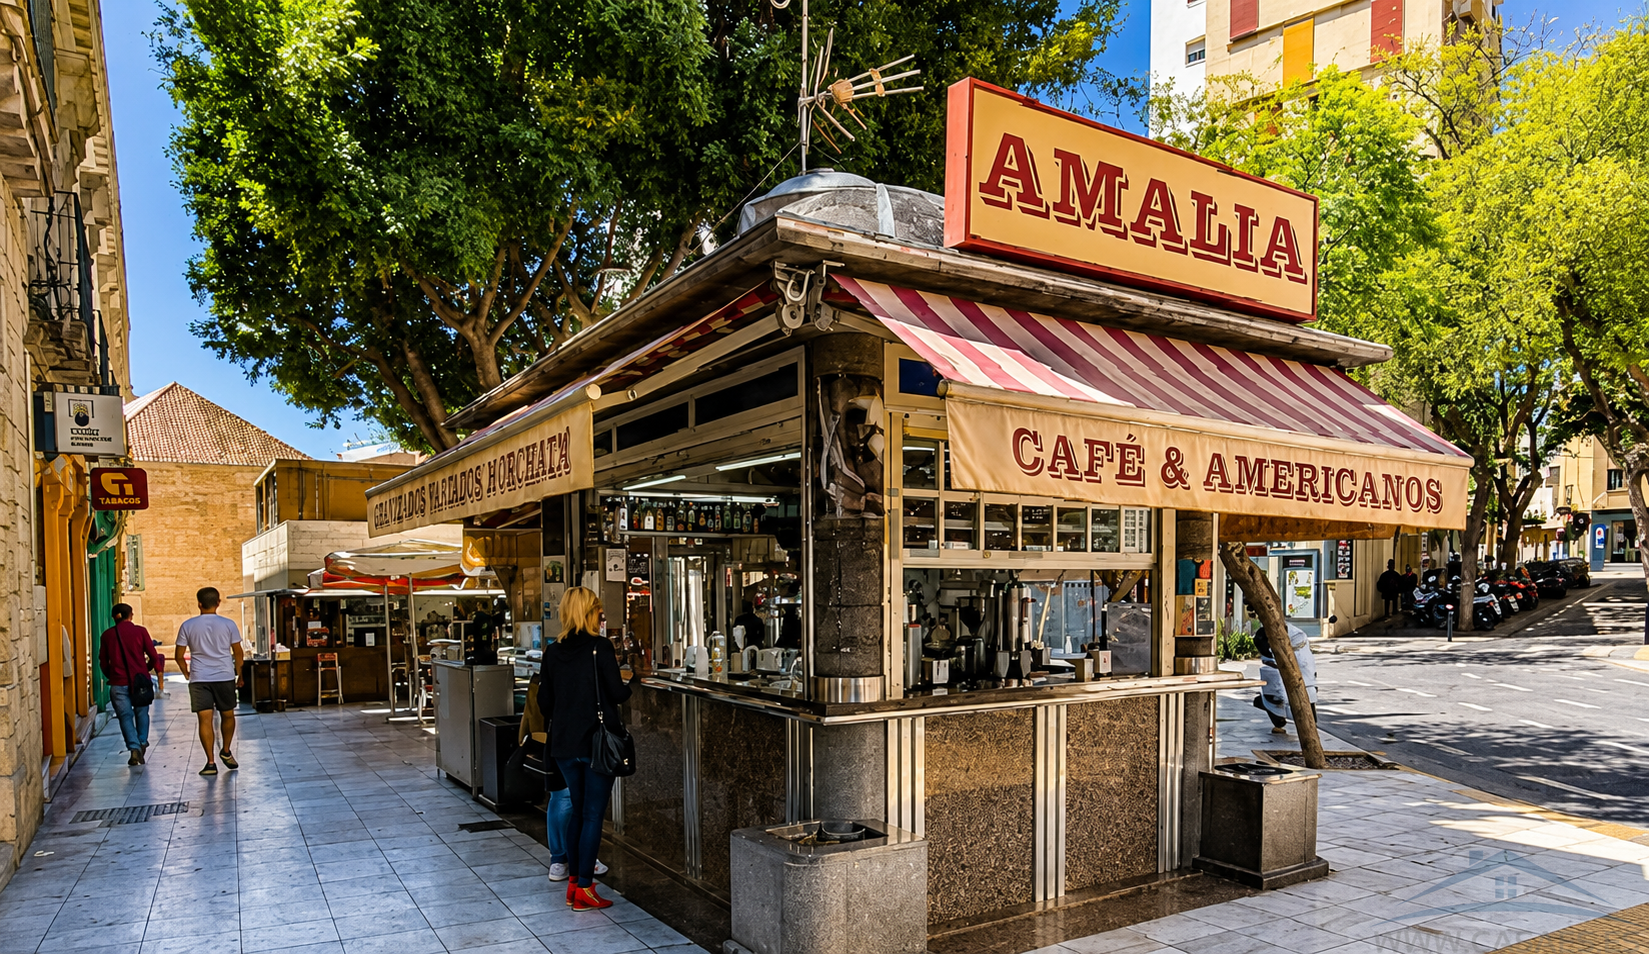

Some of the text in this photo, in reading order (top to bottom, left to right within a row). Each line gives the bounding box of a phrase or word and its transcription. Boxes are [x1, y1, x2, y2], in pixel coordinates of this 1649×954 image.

[979, 132, 1308, 285] AMALIA
[98, 497, 141, 505] TABACOS
[1012, 427, 1444, 514] CAFÉ & AMERICANOS
